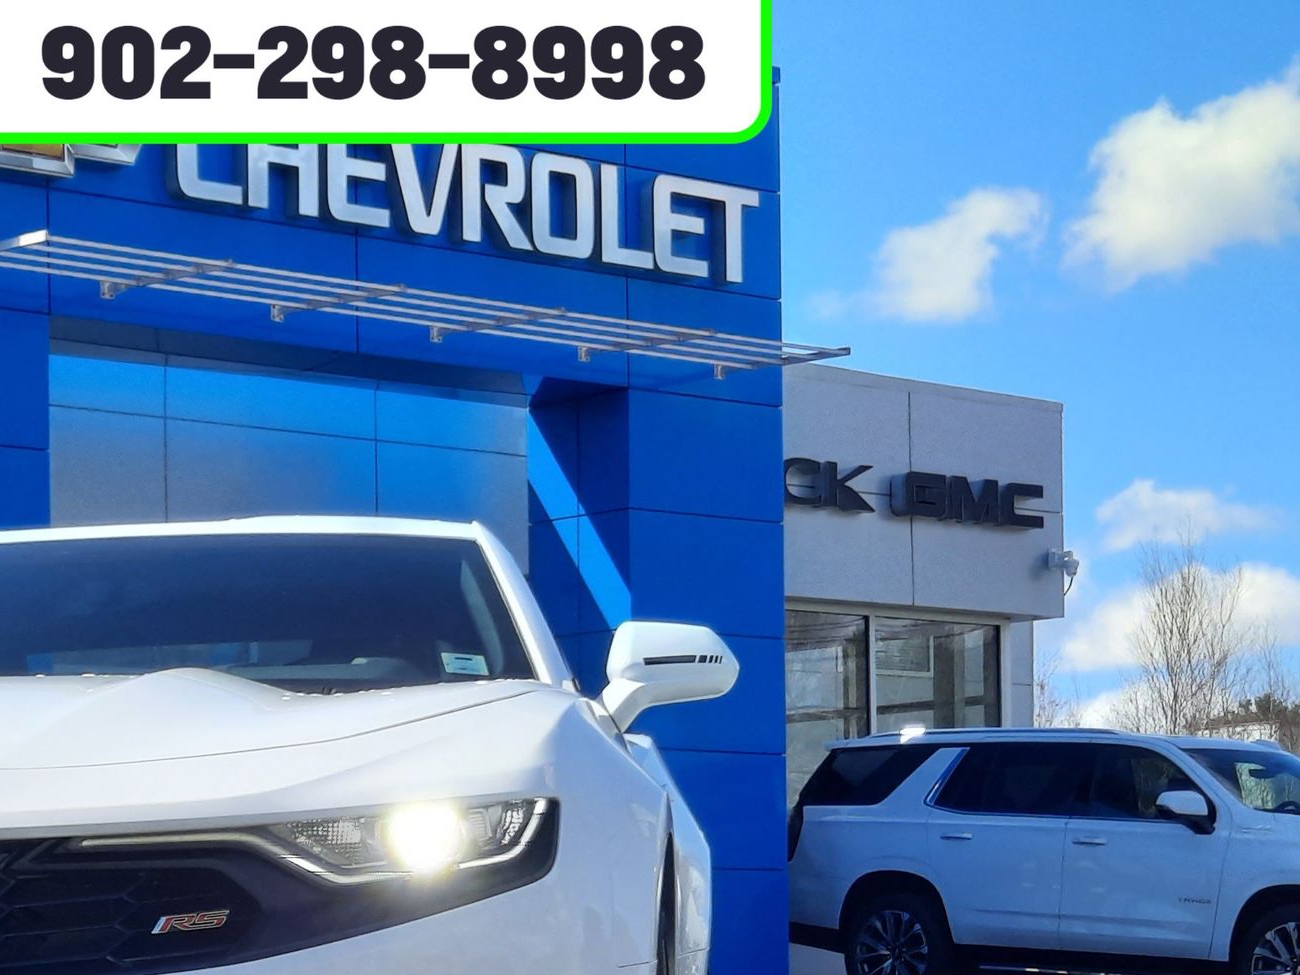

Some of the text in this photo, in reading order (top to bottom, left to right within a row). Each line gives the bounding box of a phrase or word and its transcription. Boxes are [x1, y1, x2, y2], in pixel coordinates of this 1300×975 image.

[176, 144, 760, 283] CHEVROLET
[891, 471, 1045, 529] GMC
[151, 910, 230, 935] RS
